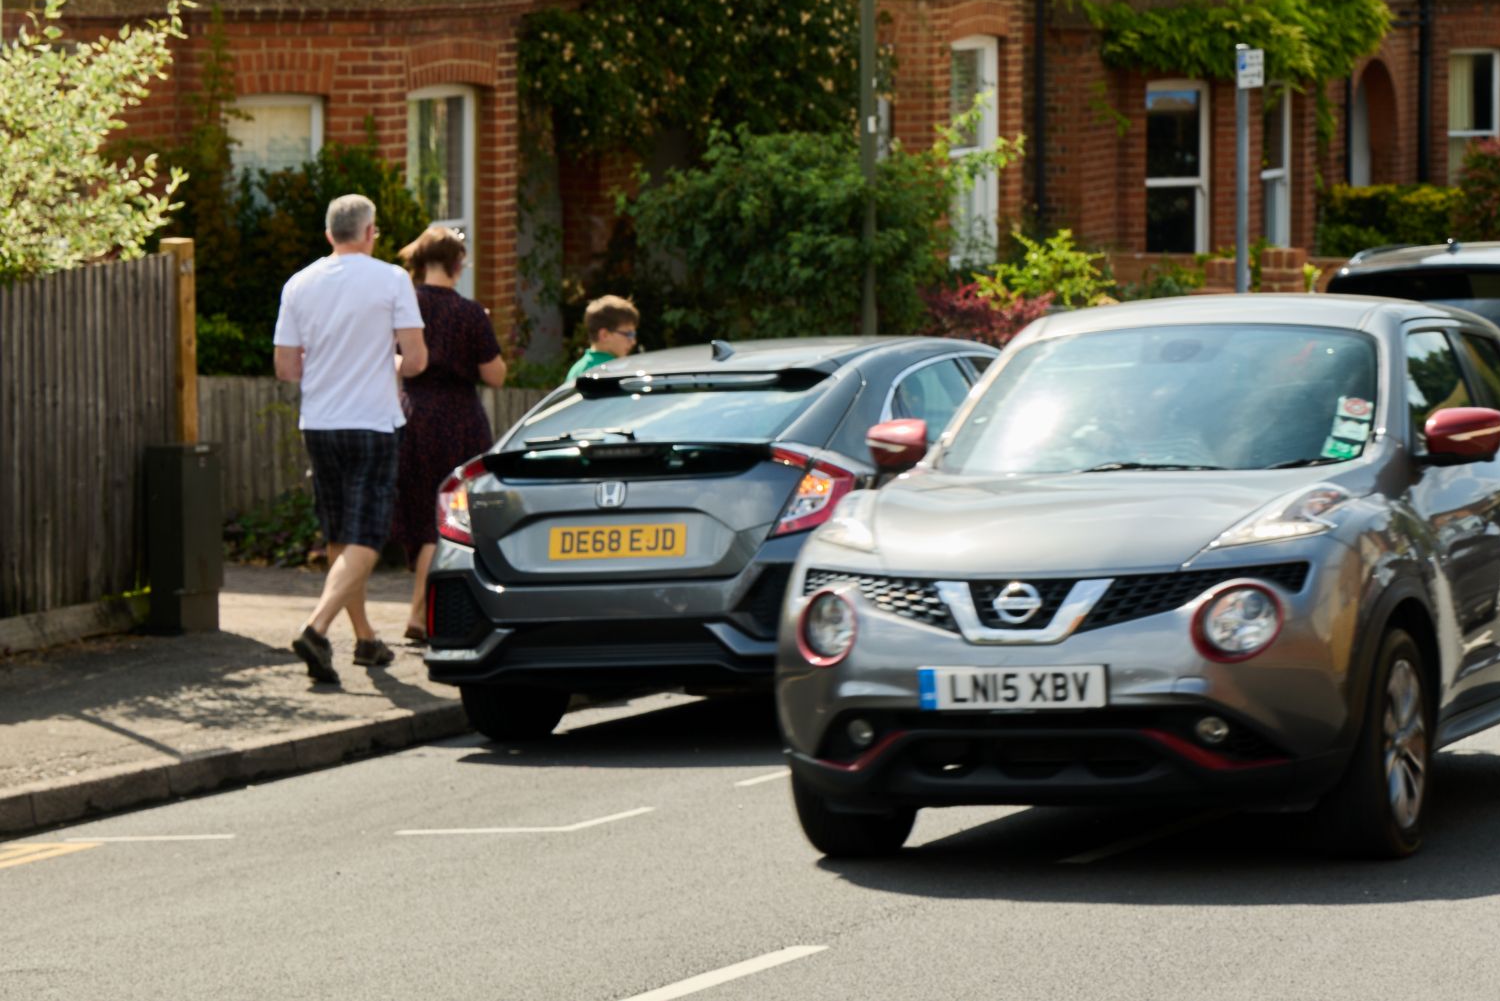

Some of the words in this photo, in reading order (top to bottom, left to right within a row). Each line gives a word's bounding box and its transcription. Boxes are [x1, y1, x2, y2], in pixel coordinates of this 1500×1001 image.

[560, 530, 621, 554] DE68
[629, 527, 676, 552] EJD
[949, 672, 1019, 704] LN15
[1028, 672, 1090, 702] XBV
